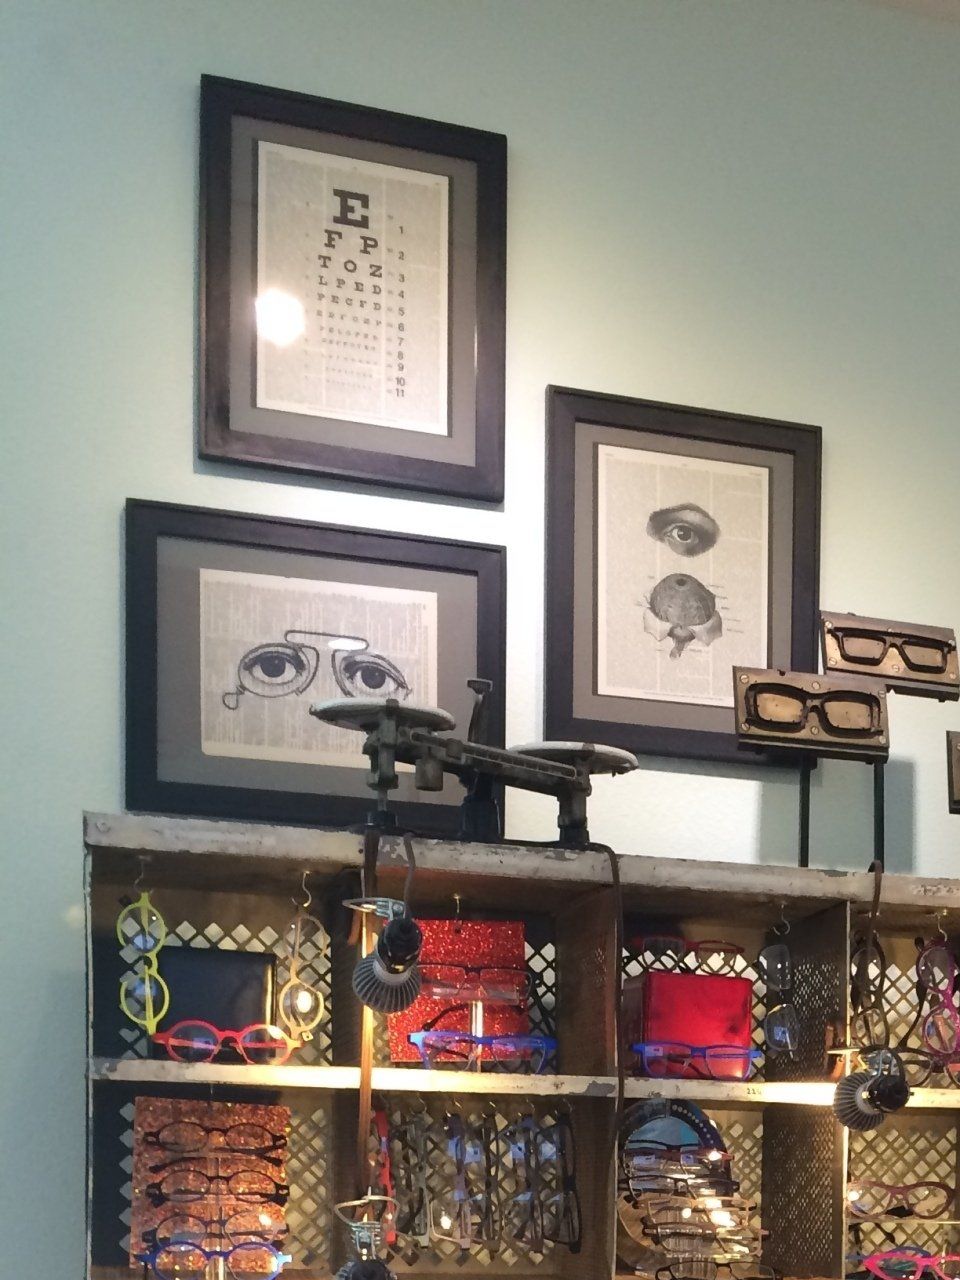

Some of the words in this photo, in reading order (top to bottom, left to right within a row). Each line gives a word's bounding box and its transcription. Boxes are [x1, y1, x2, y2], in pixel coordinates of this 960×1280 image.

[333, 188, 369, 229] E
[324, 229, 342, 249] F
[360, 235, 378, 255] P
[395, 376, 406, 387] 10
[395, 388, 405, 397] 11
